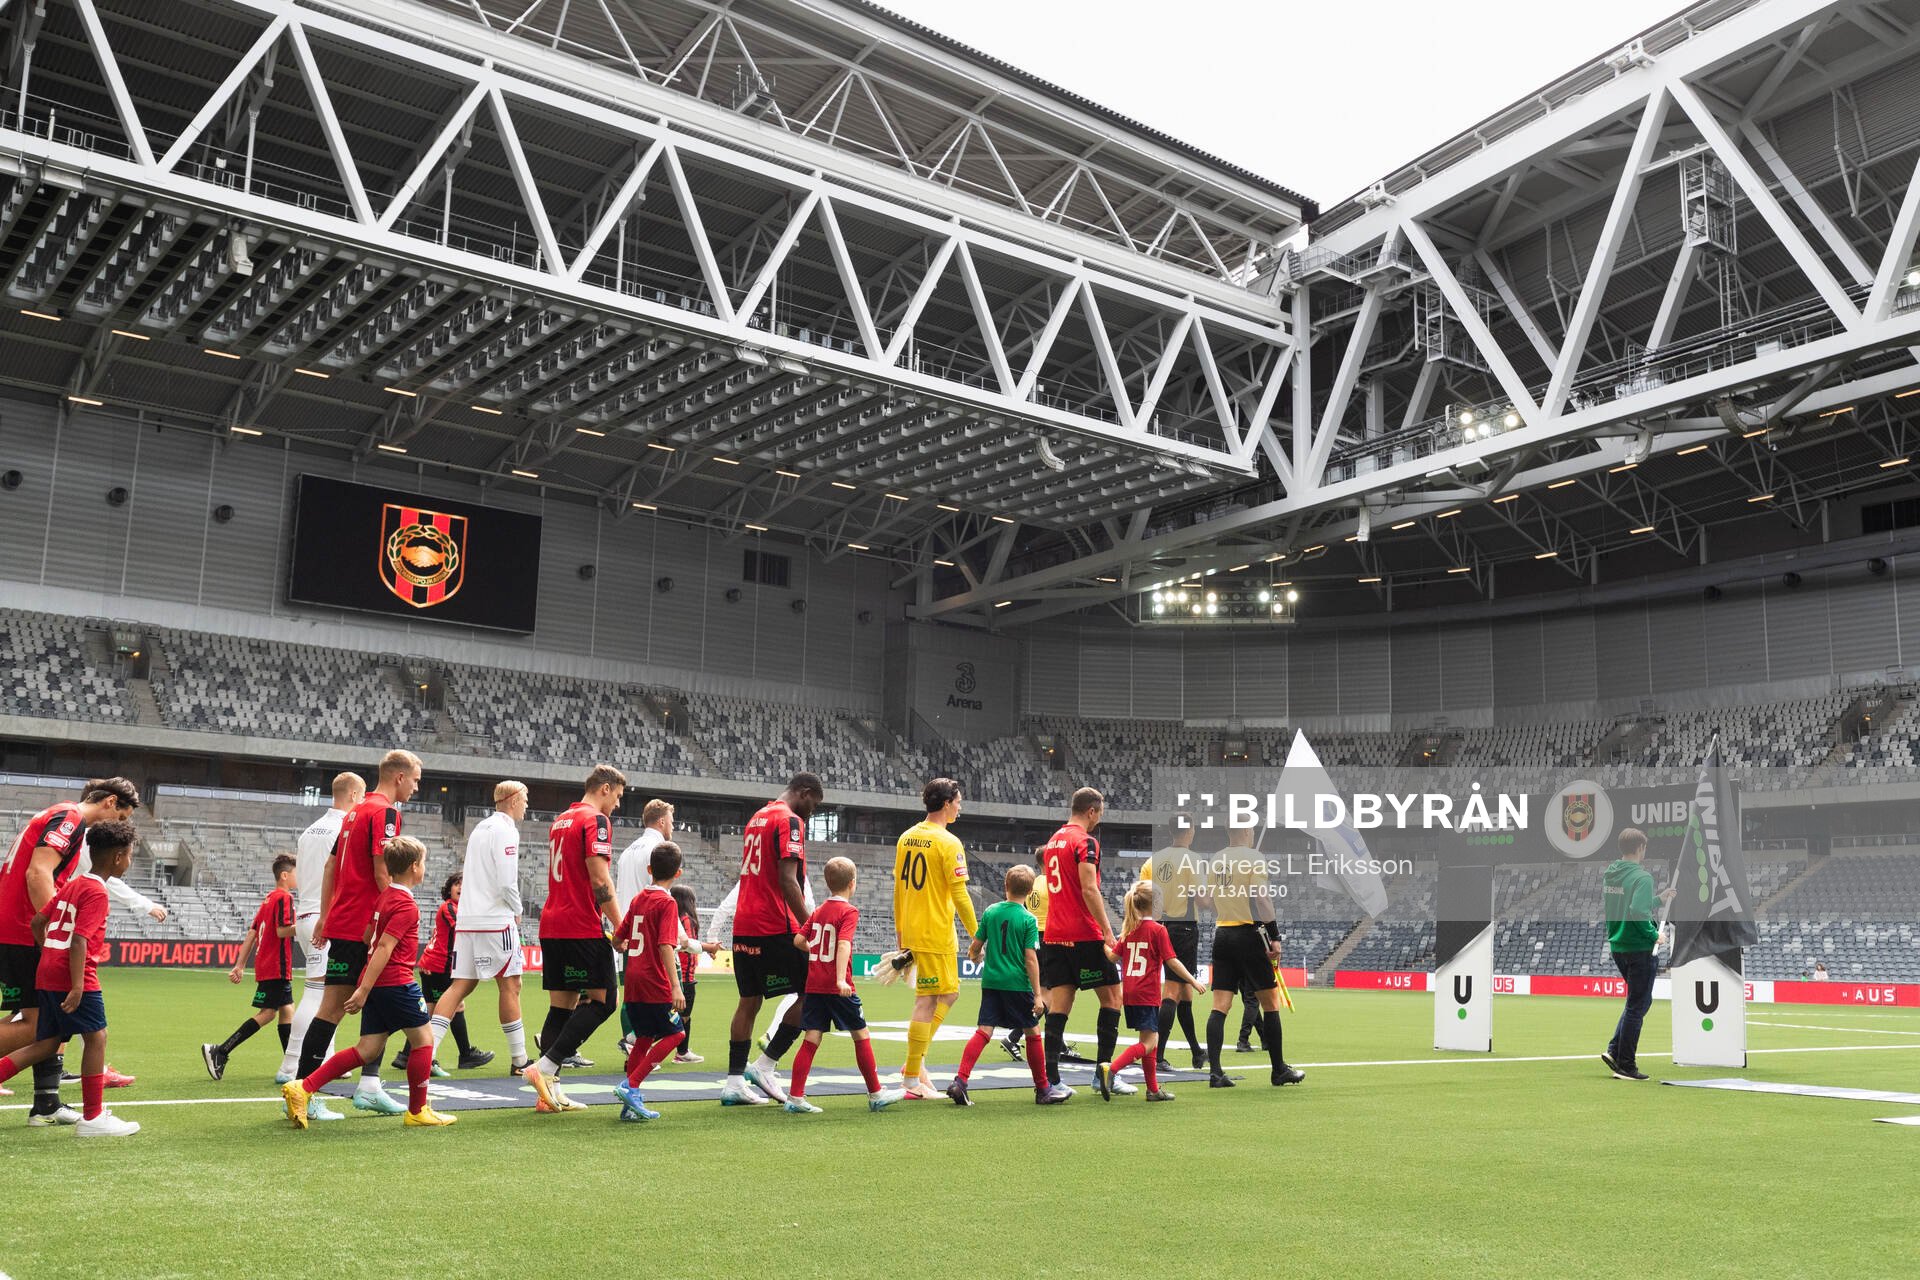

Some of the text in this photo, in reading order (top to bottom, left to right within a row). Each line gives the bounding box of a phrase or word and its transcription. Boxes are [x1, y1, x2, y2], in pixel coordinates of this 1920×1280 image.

[946, 694, 983, 711] Arena
[1631, 801, 1696, 825] UNIB
[550, 837, 564, 883] 16
[740, 833, 762, 876] 23
[901, 850, 927, 891] 40
[1048, 855, 1062, 894] 3
[44, 900, 77, 950] 23
[628, 915, 645, 957] 5
[808, 922, 837, 963] 20
[1000, 919, 1009, 955] 1
[120, 941, 214, 965] TOPPLAGET
[1126, 941, 1149, 977] 15
[917, 977, 939, 985] coop
[1454, 975, 1473, 1005] U
[1695, 981, 1719, 1014] U
